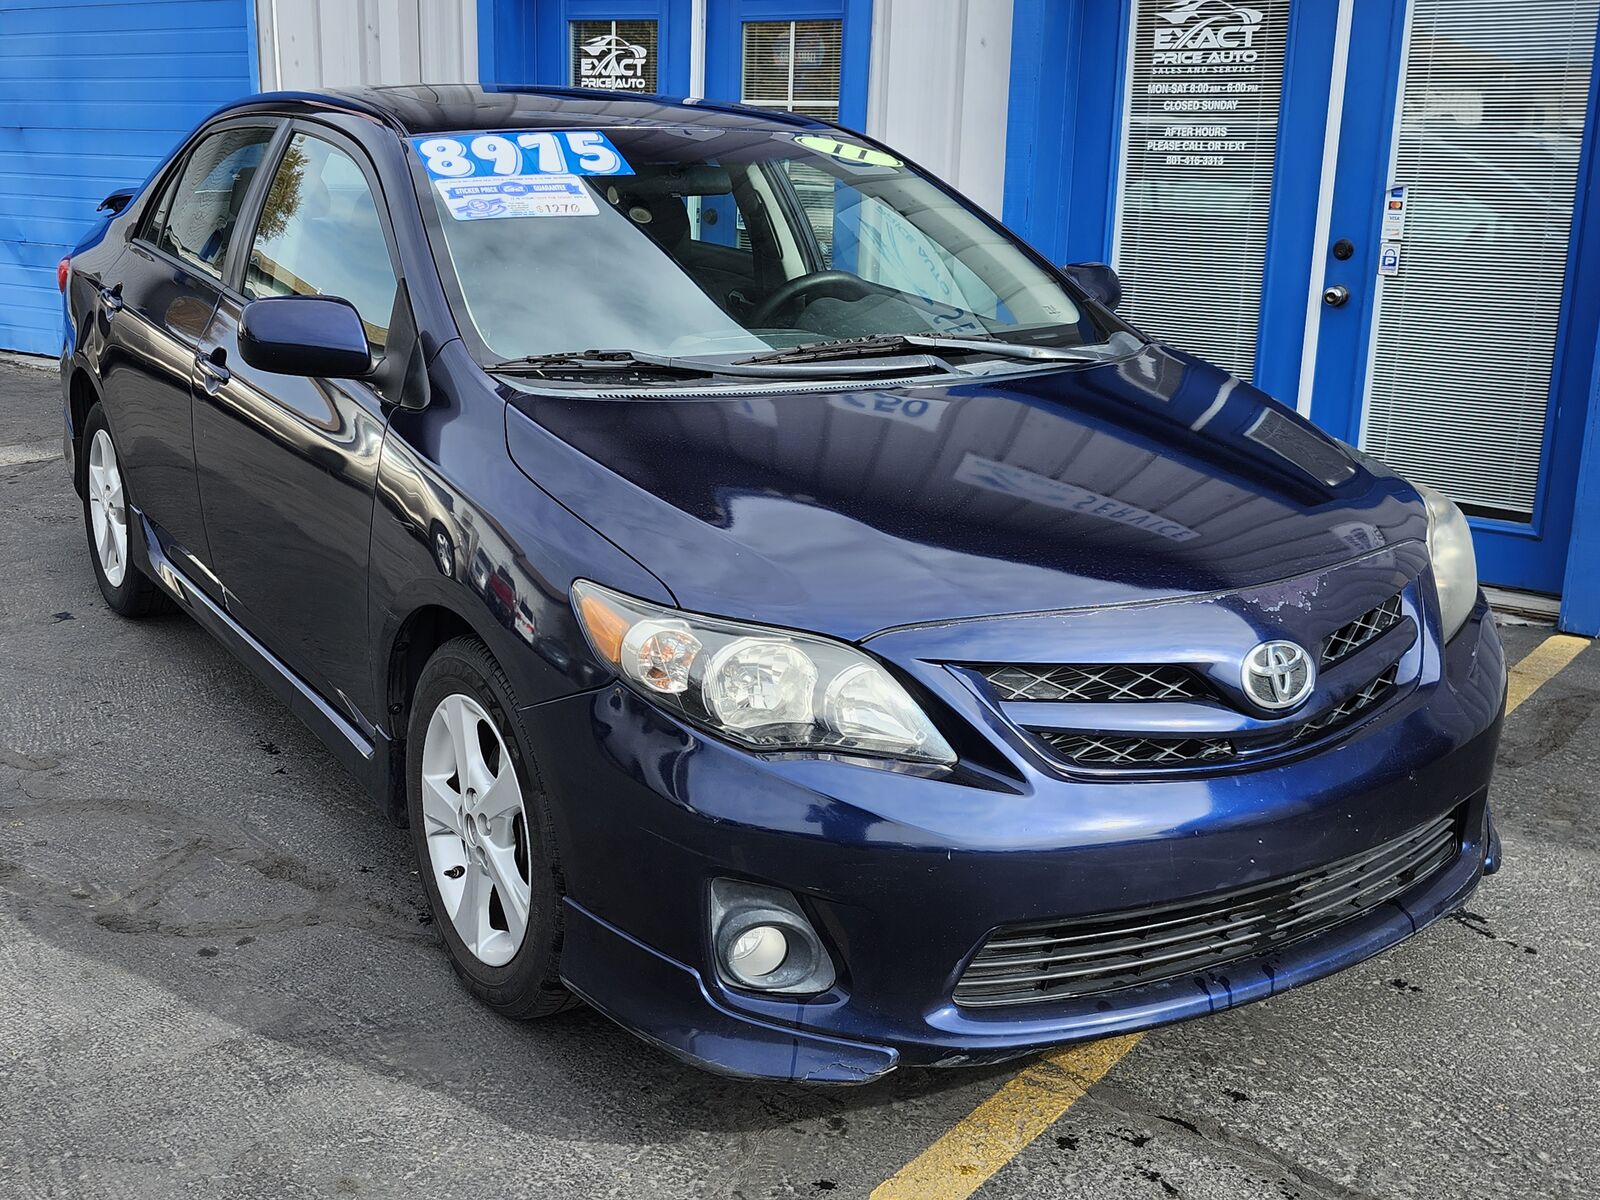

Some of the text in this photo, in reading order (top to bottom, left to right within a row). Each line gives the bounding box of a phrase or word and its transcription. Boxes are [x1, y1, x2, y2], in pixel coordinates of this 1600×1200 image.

[1154, 25, 1261, 49] EXACT
[1152, 50, 1258, 65] PRICE AUTO
[580, 58, 647, 76] EXACT
[1152, 65, 1257, 75] SALES AND SERVICE
[581, 77, 646, 89] PRICE AUTO
[1148, 83, 1190, 94] MON-SAT
[1163, 100, 1239, 111] CLOSED SUNDAY
[1165, 127, 1228, 137] AFTER HOURS
[1147, 141, 1247, 151] PLEASE CALL OR TEXT
[419, 133, 620, 176] 8975
[455, 187, 481, 196] STICKER
[481, 185, 499, 194] PRICE
